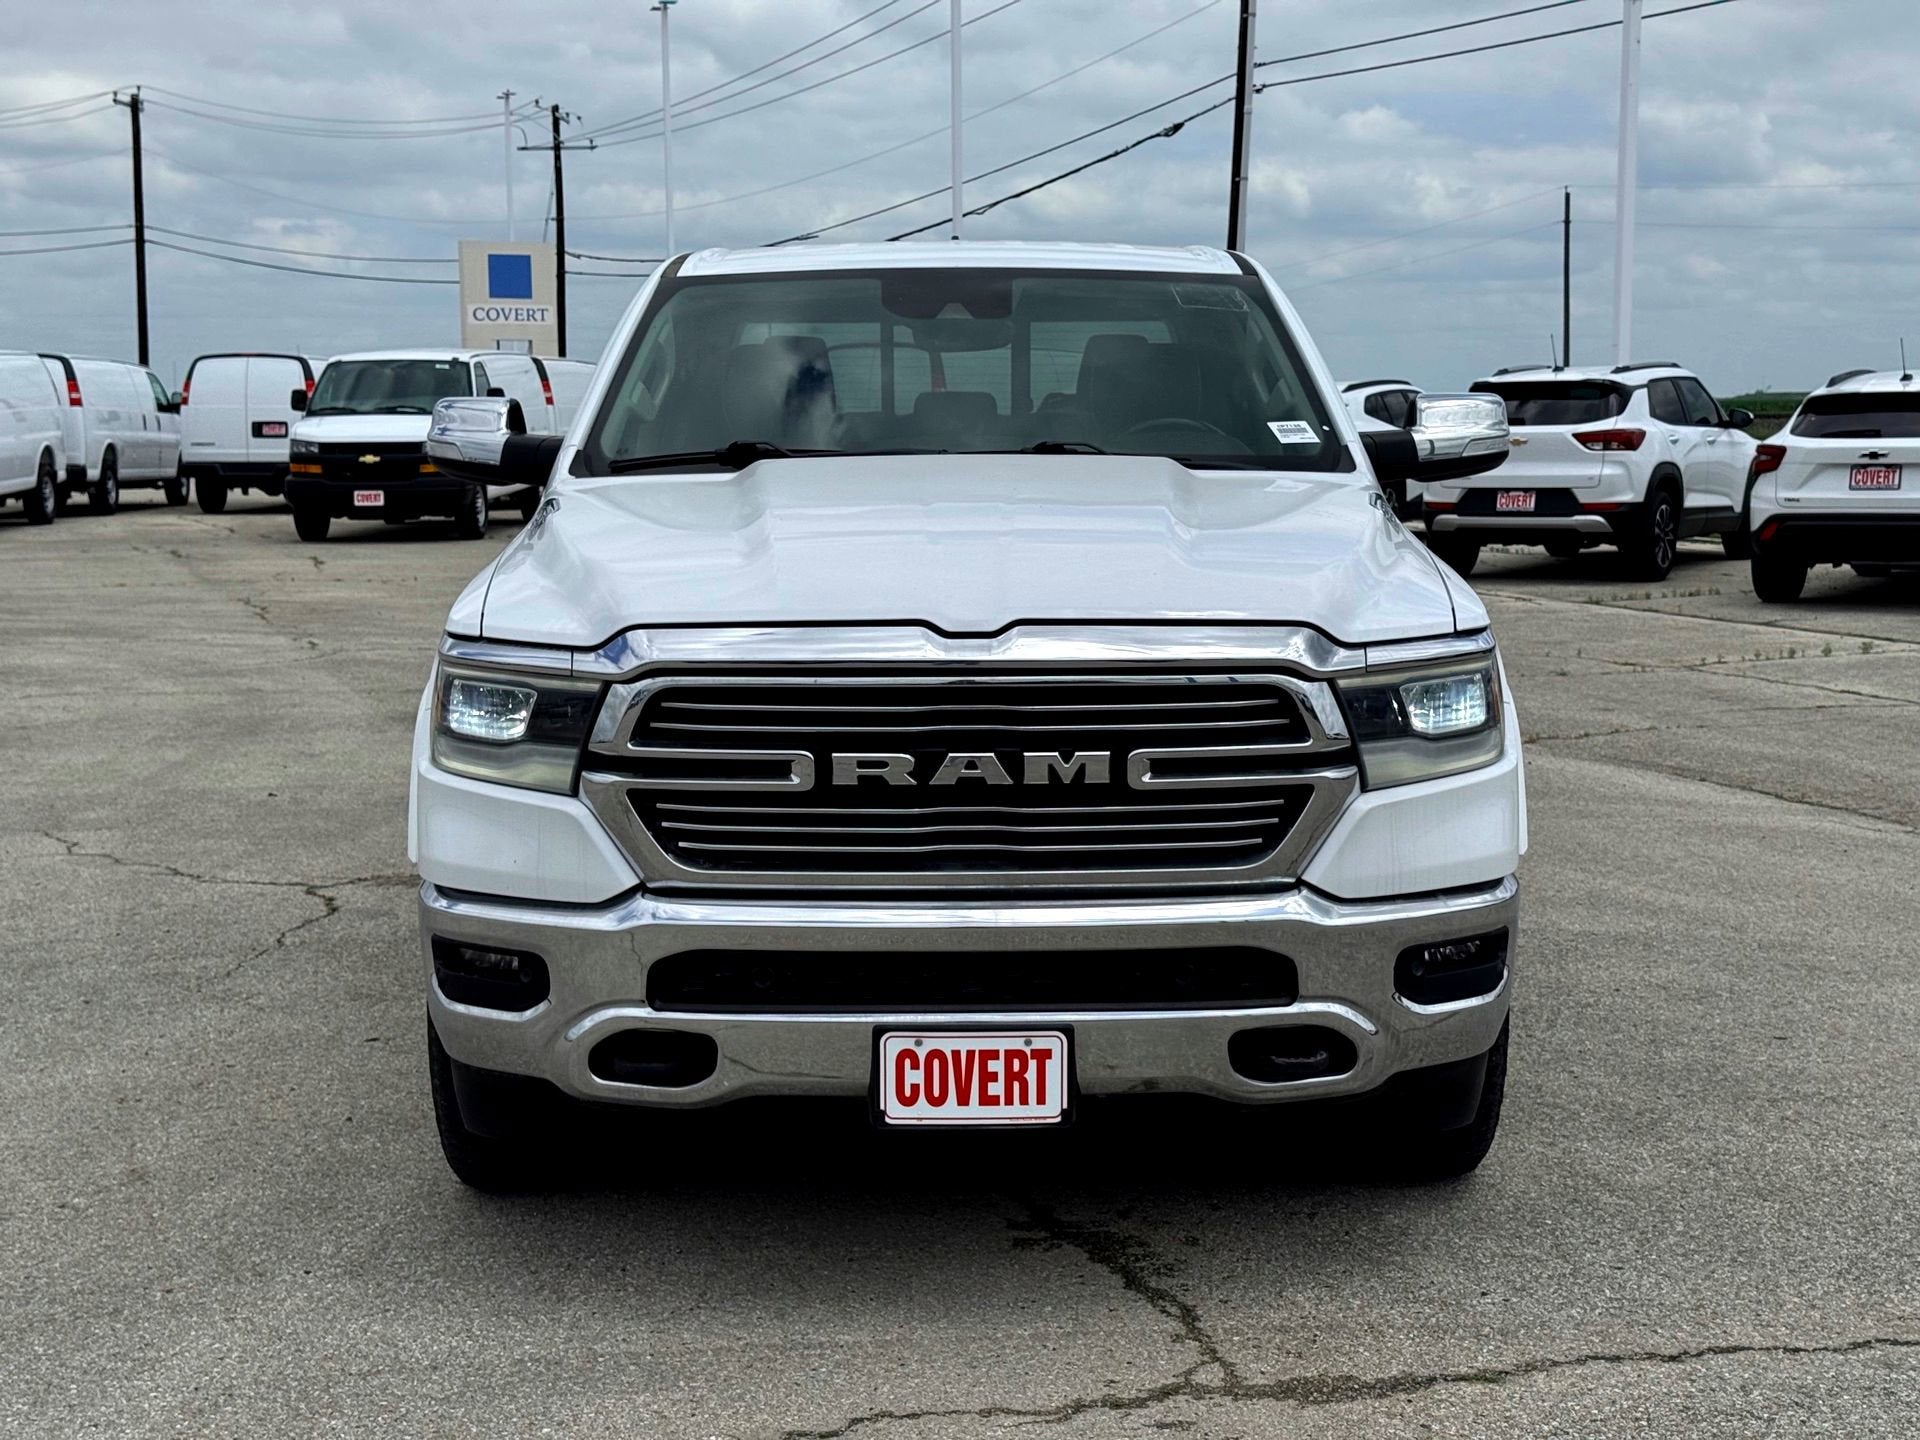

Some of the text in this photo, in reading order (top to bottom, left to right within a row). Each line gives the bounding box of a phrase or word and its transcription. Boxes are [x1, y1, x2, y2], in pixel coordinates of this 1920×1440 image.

[473, 307, 549, 322] COVERT
[1854, 469, 1897, 485] COVERT
[1499, 495, 1532, 508] COVERT
[831, 751, 1111, 786] RAM
[895, 1048, 1053, 1107] COVERT
